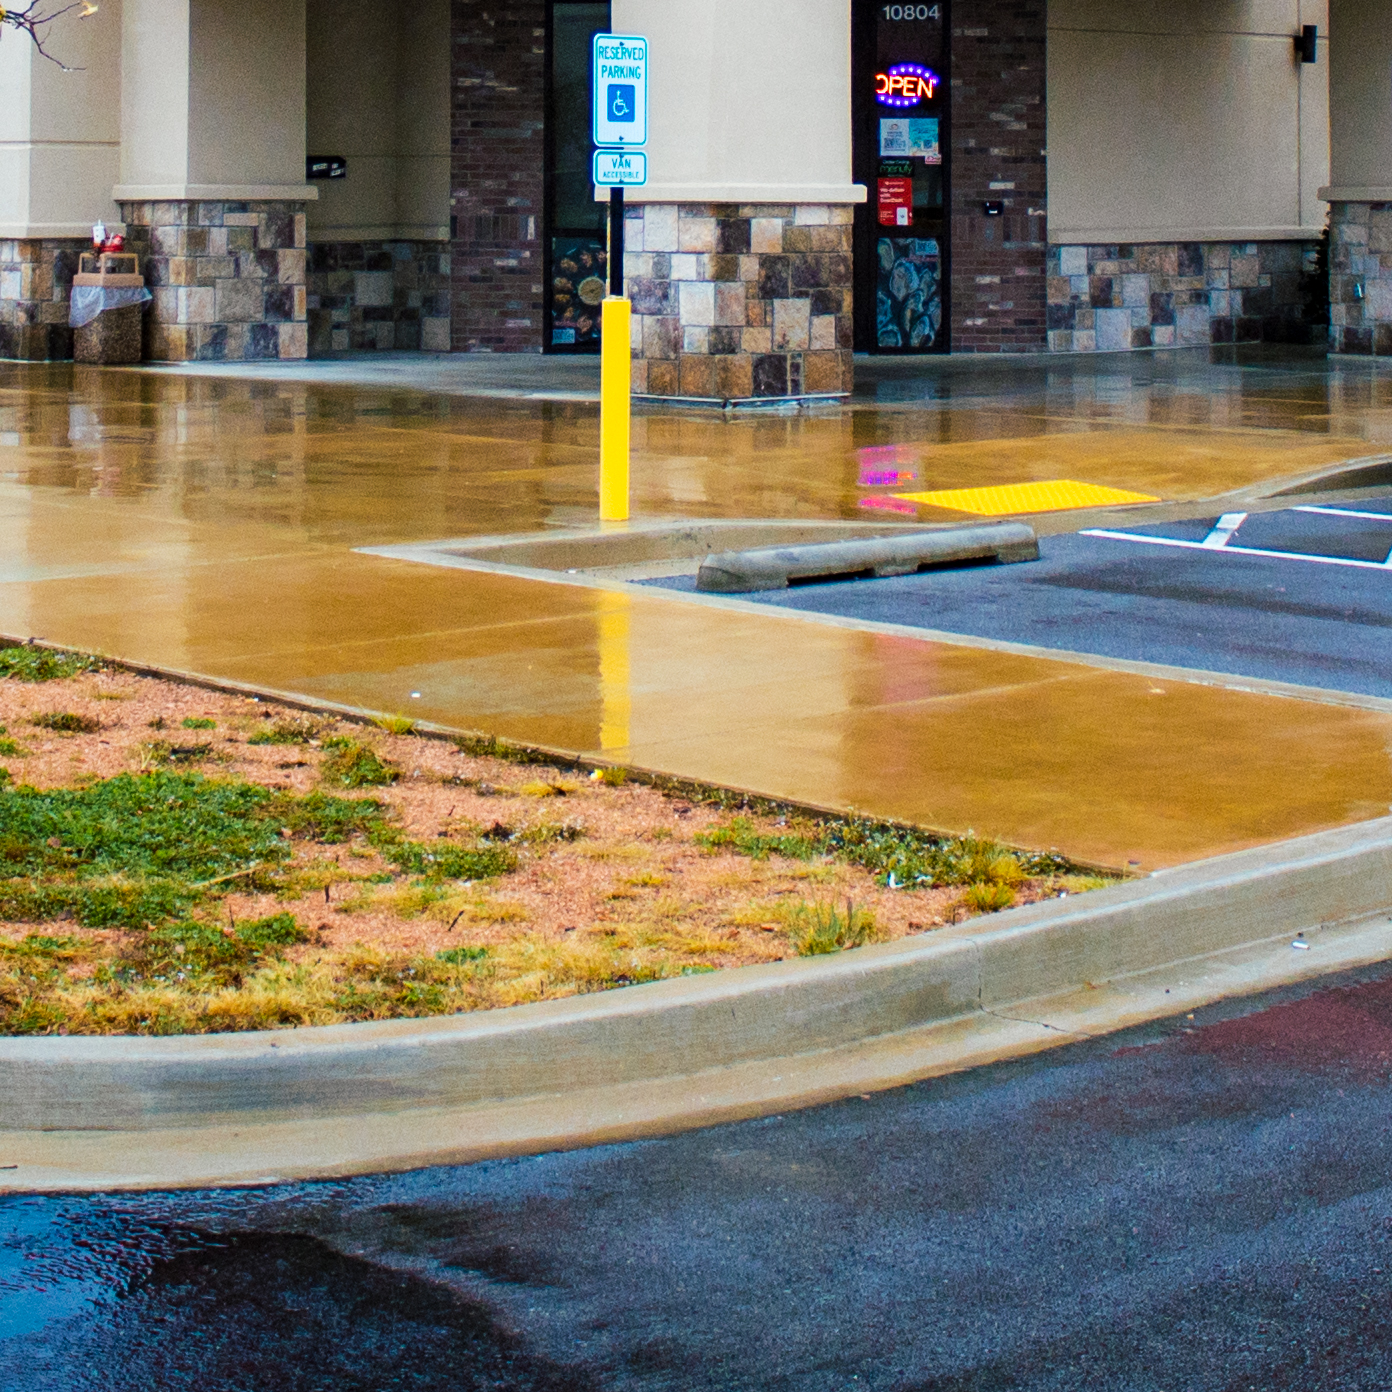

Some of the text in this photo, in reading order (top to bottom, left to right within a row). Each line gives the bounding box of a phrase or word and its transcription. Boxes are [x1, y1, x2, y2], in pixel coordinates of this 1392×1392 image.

[882, 4, 941, 20] 10804
[598, 45, 644, 61] RESERVED
[601, 64, 642, 80] PARKING
[875, 73, 933, 99] OPEN
[611, 158, 632, 170] VAN
